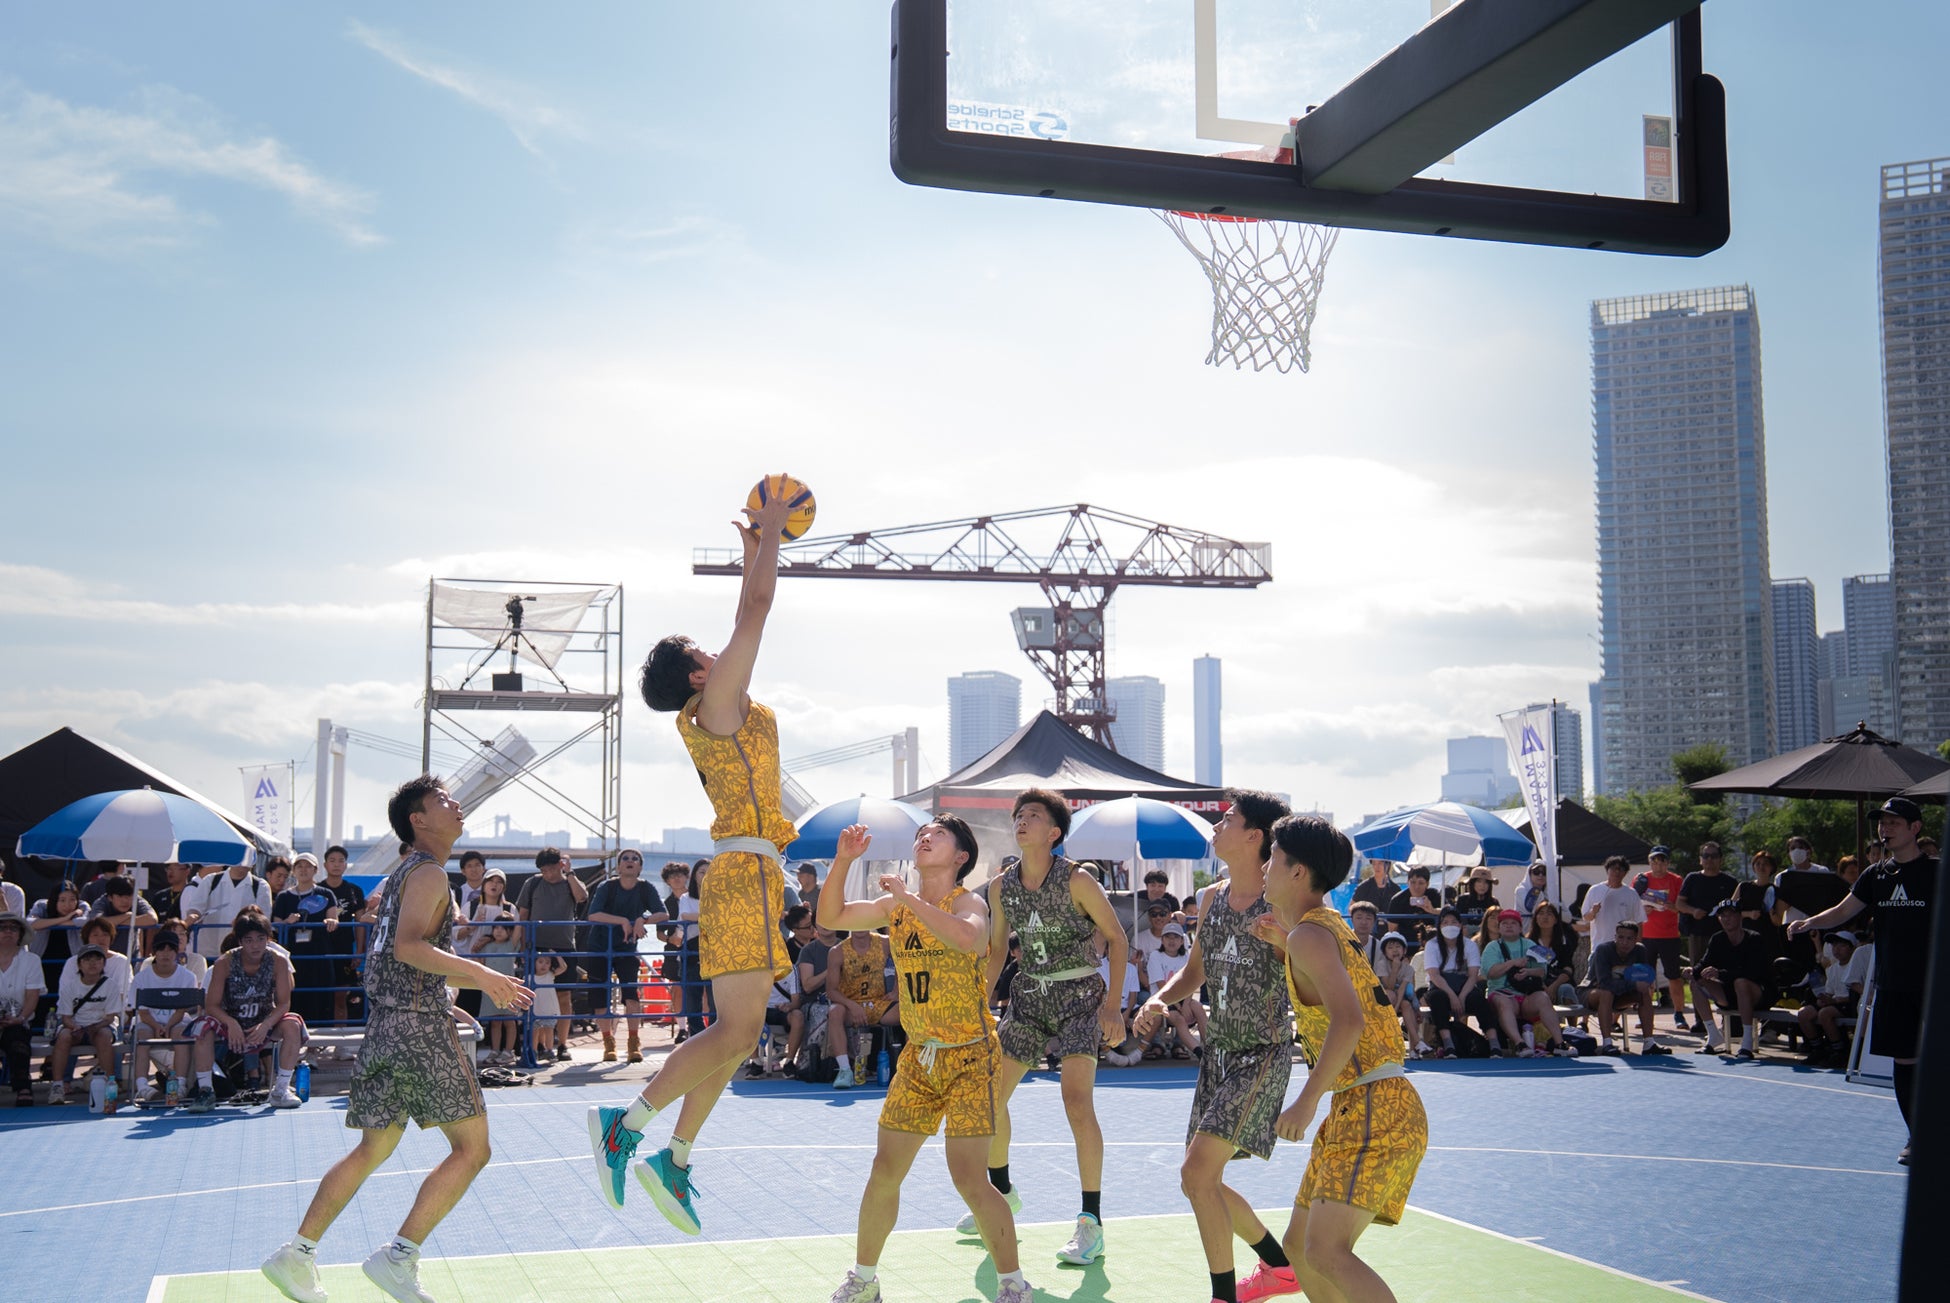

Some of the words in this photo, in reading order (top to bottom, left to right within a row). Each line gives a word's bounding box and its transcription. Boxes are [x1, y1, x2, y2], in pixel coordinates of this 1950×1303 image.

[1032, 941, 1048, 965] 3
[861, 981, 869, 996] 2
[904, 970, 930, 1005] 10
[238, 1003, 259, 1018] 30
